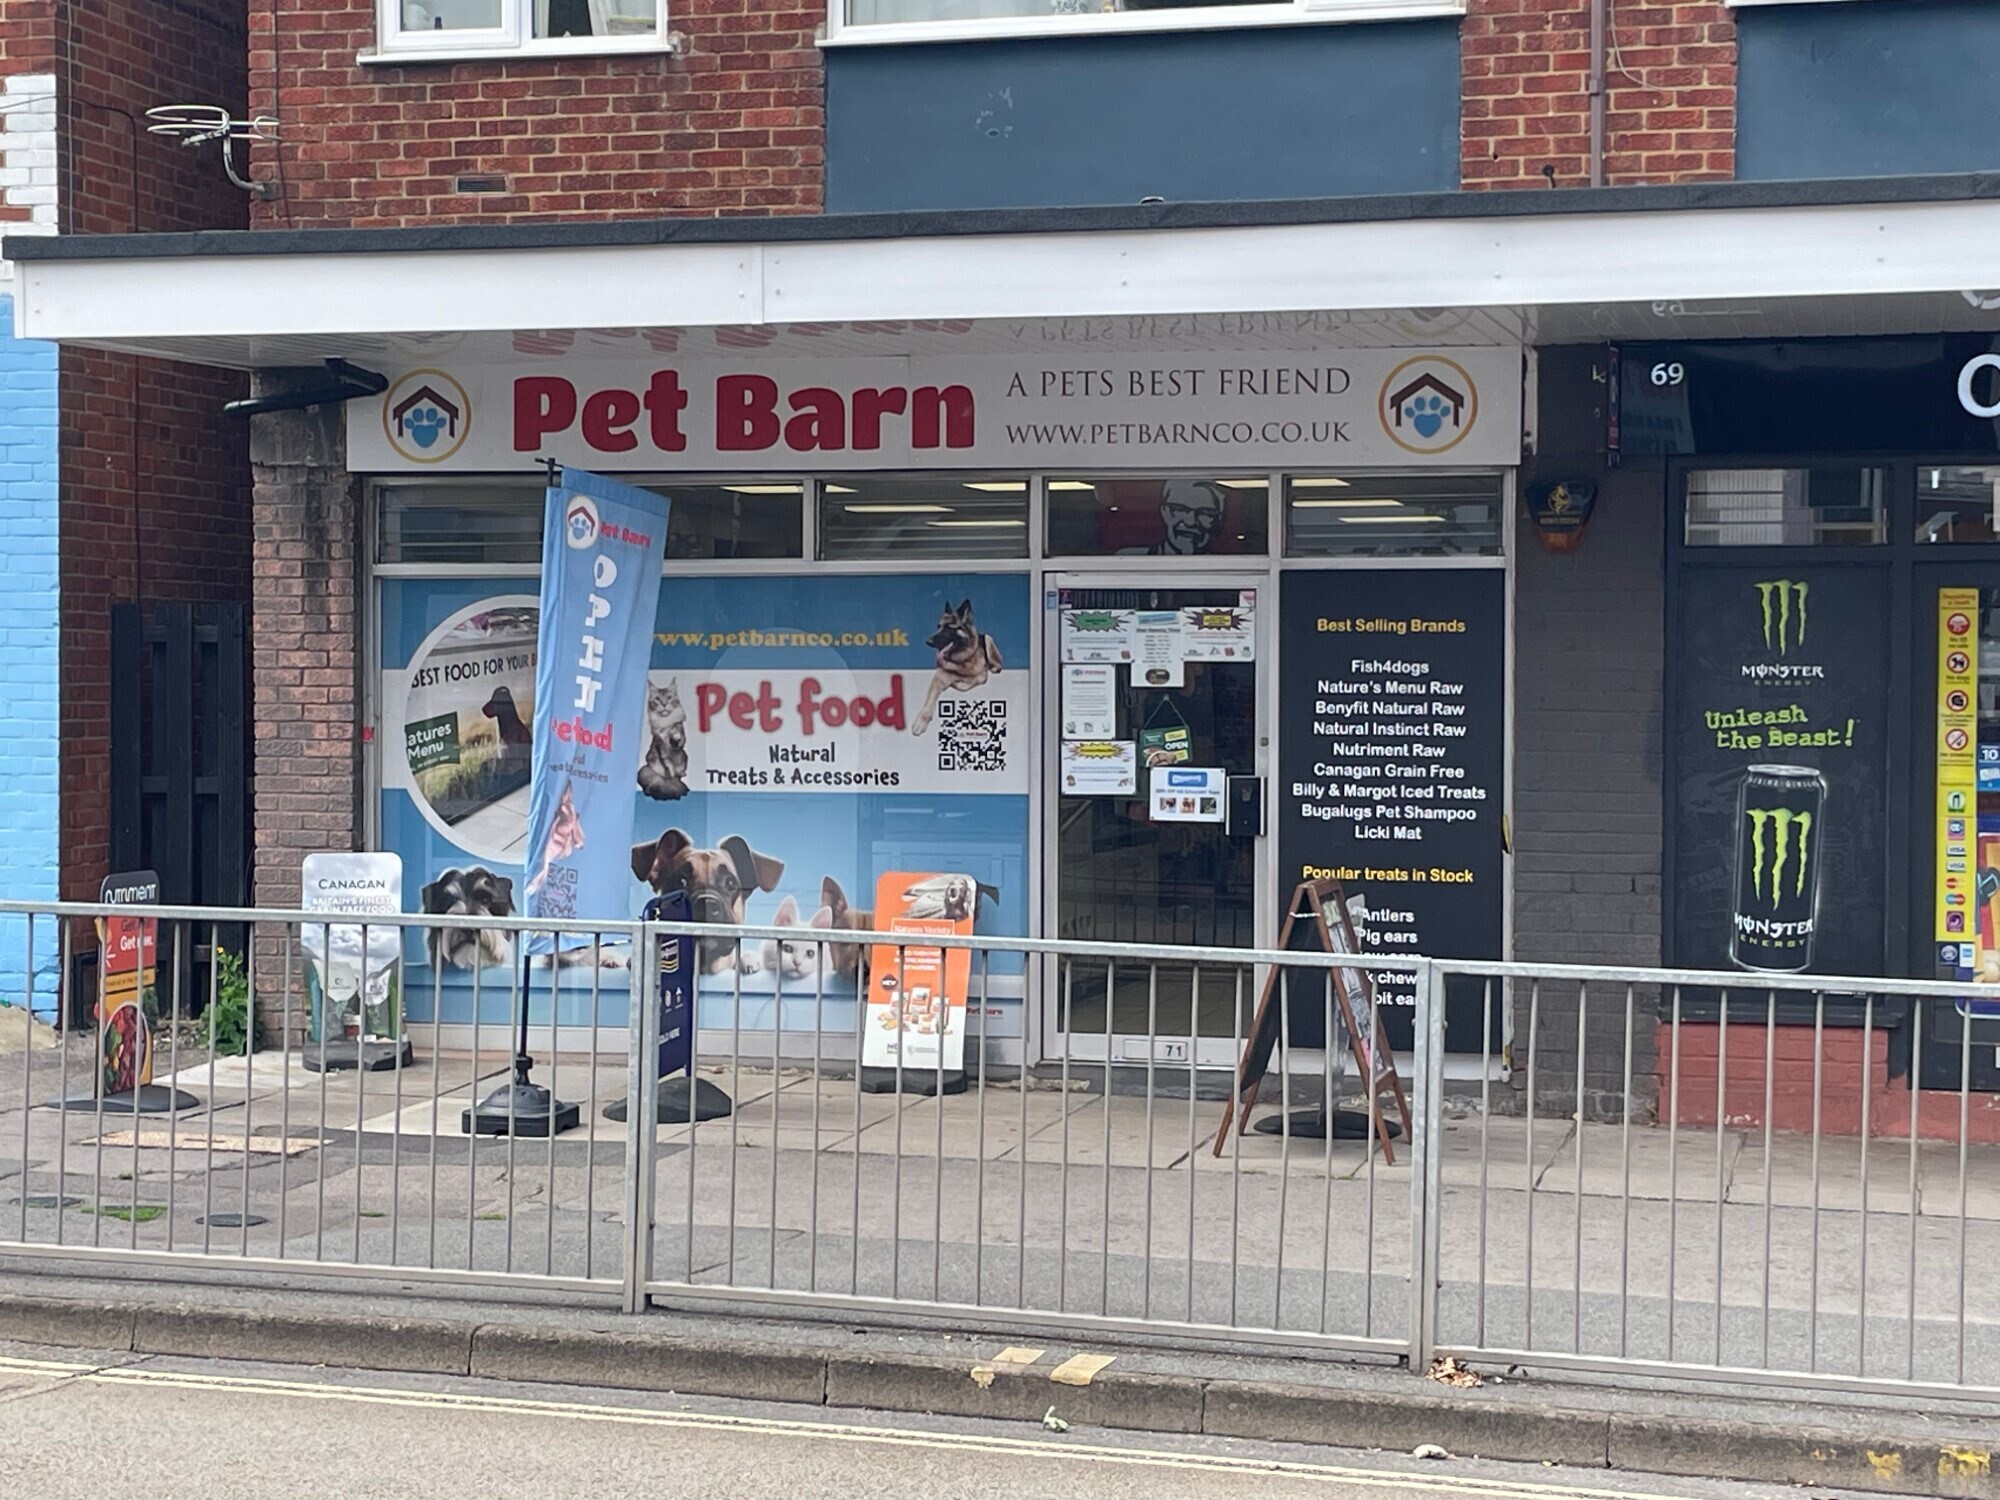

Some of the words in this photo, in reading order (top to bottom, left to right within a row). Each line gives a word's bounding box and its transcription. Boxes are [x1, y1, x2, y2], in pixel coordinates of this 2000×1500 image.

[1006, 370, 1028, 398] A
[1040, 370, 1114, 398] PETS
[1129, 369, 1205, 397] BEST
[1218, 367, 1352, 396] FRIEND
[1651, 362, 1684, 386] 69
[513, 370, 688, 452] Pet
[716, 373, 975, 452] Barn
[1006, 421, 1352, 446] WWW.PETBARNCO.CO.UK
[1317, 618, 1351, 632] Best
[1355, 618, 1407, 635] Selling
[1410, 619, 1466, 633] Brands
[654, 628, 910, 651] ww.petbarnco.co.uk
[445, 661, 480, 683] FOOD
[483, 658, 504, 676] FOR
[506, 653, 529, 670] YOUR
[1351, 660, 1430, 677] Fish4dogs
[1741, 663, 1825, 679] MONSTER
[1317, 681, 1382, 694] Nature's
[1385, 681, 1426, 694] Menu
[1430, 681, 1464, 695] Raw
[695, 681, 783, 734] Pet
[797, 674, 906, 736] food
[1315, 701, 1369, 717] Benyfit
[1372, 701, 1428, 715] Natural
[1432, 702, 1465, 716] Raw
[1705, 704, 1809, 730] Unleash
[1313, 722, 1368, 736] Natural
[1372, 722, 1430, 736] Instinct
[1433, 723, 1467, 737] Raw
[1164, 741, 1189, 750] OPEN
[1717, 730, 1762, 750] the
[407, 740, 444, 761] Menu
[769, 742, 836, 764] Natural
[1333, 742, 1409, 757] Nutriment
[1412, 743, 1446, 757] Raw
[1982, 749, 1999, 760] 10
[705, 768, 768, 786] Treats
[773, 768, 786, 785] &
[790, 768, 900, 786] Accessories
[1313, 763, 1381, 779] Canagan
[1384, 764, 1426, 778] Grain
[1430, 764, 1465, 778] Free
[1292, 783, 1325, 799] Billy
[1328, 783, 1340, 797] &
[1344, 784, 1397, 800] Margot
[1400, 785, 1434, 798] Iced
[1437, 785, 1487, 799] Treats
[1301, 804, 1372, 821] Bugalugs
[1375, 805, 1401, 818] Pet
[1404, 805, 1477, 823] Shampoo
[1355, 825, 1390, 839] Licki
[1393, 826, 1422, 840] Mat
[1303, 865, 1361, 880] Popular
[1364, 867, 1408, 881] treats
[1412, 868, 1426, 881] in
[1429, 868, 1474, 883] Stock
[1362, 908, 1415, 923] Antlers
[120, 934, 136, 951] Get
[1384, 931, 1418, 944] ears
[1166, 1045, 1182, 1057] 71
